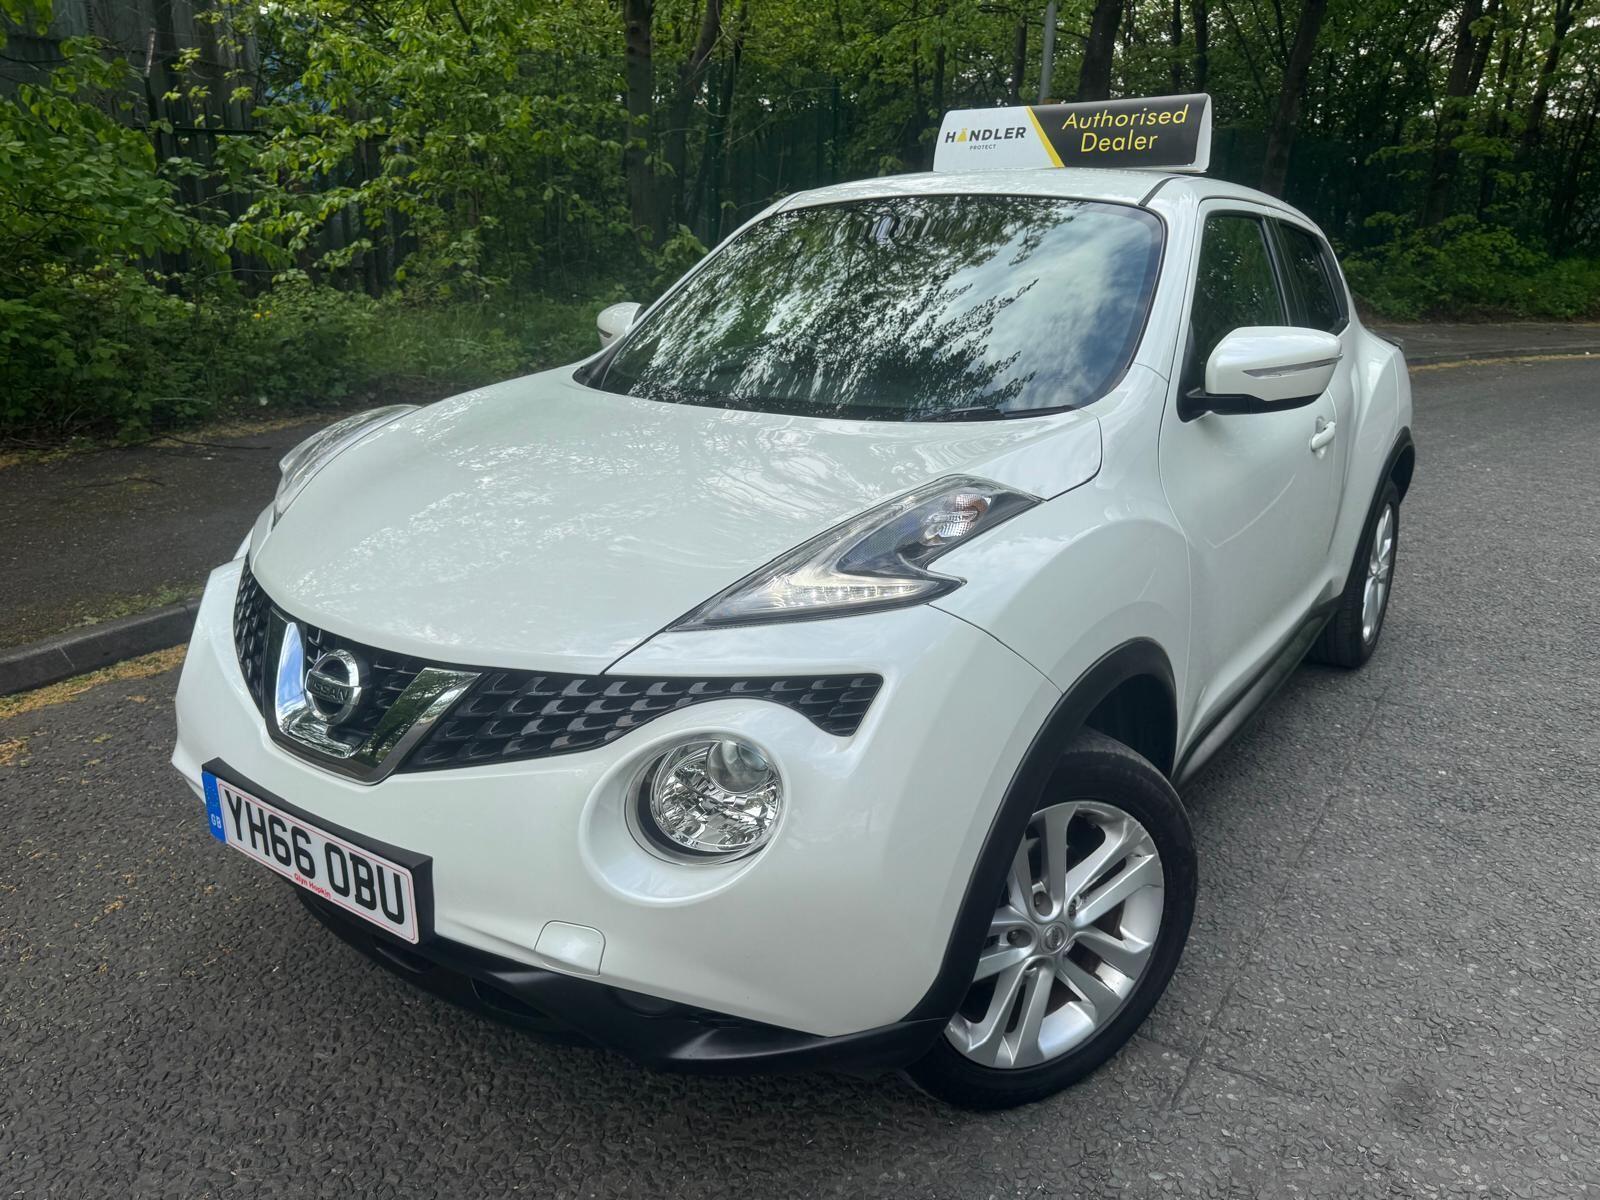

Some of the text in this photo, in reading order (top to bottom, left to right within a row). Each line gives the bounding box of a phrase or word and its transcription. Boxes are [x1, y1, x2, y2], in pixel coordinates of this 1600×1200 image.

[1061, 103, 1189, 130] Authorised
[1081, 129, 1159, 152] Dealer
[210, 813, 222, 829] GB
[225, 790, 405, 925] YH66 OBU
